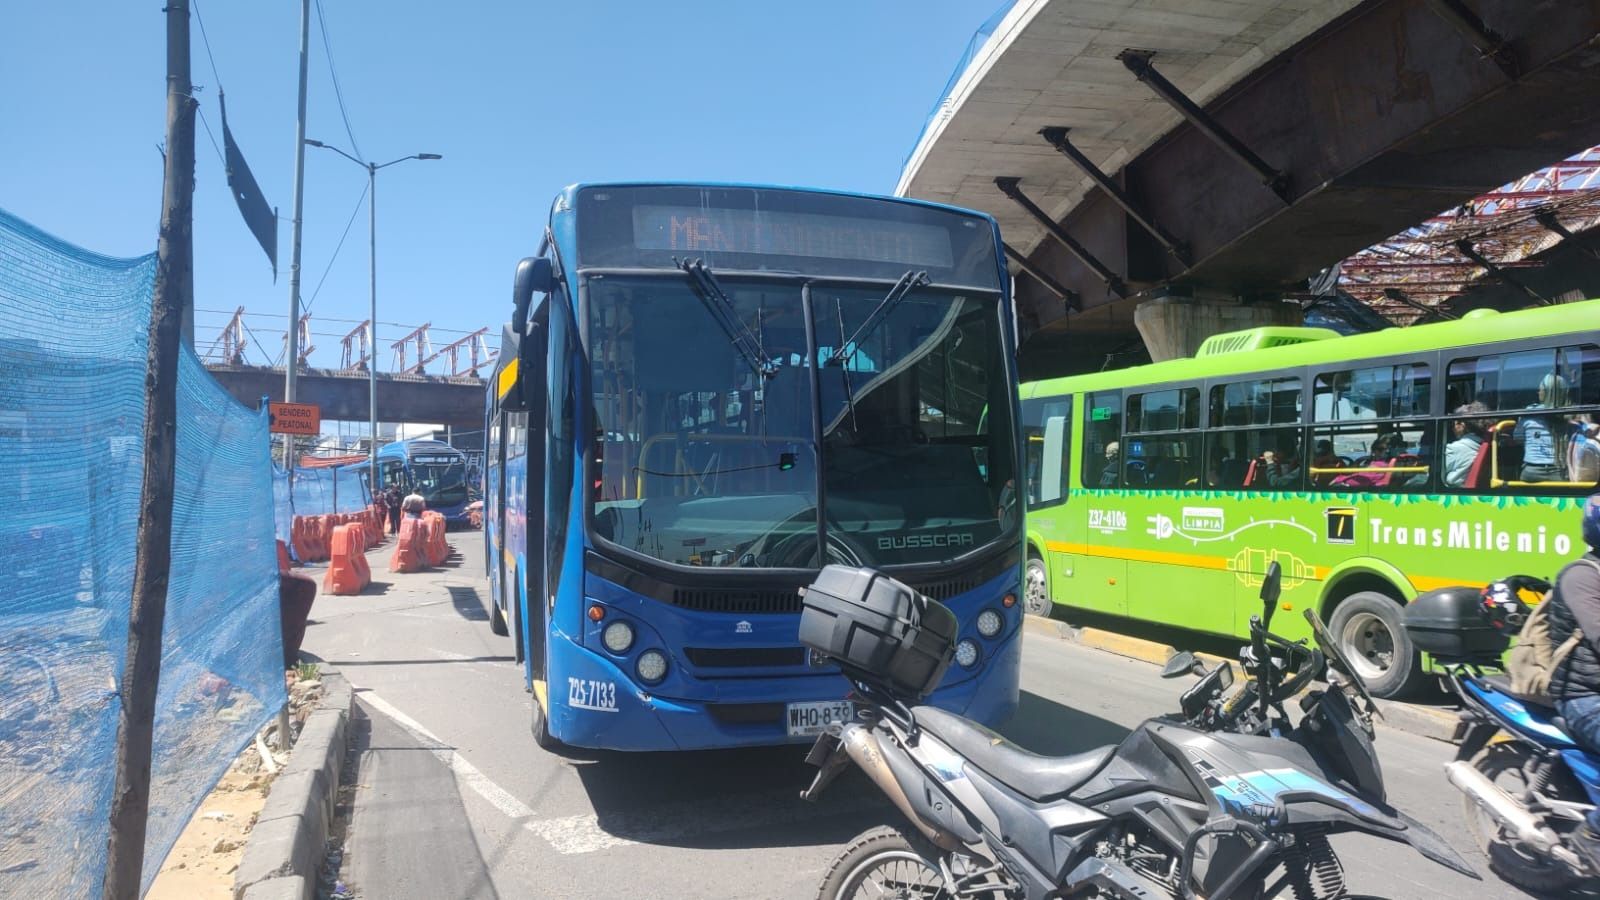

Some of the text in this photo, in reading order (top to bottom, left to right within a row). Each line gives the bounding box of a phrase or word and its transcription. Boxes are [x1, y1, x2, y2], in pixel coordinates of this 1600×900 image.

[279, 407, 311, 417] SENDERO
[278, 419, 312, 430] PEATONAL
[1185, 517, 1221, 529] LIMPIA
[877, 533, 974, 550] BUSSCAR
[1370, 517, 1571, 555] TransMilenio
